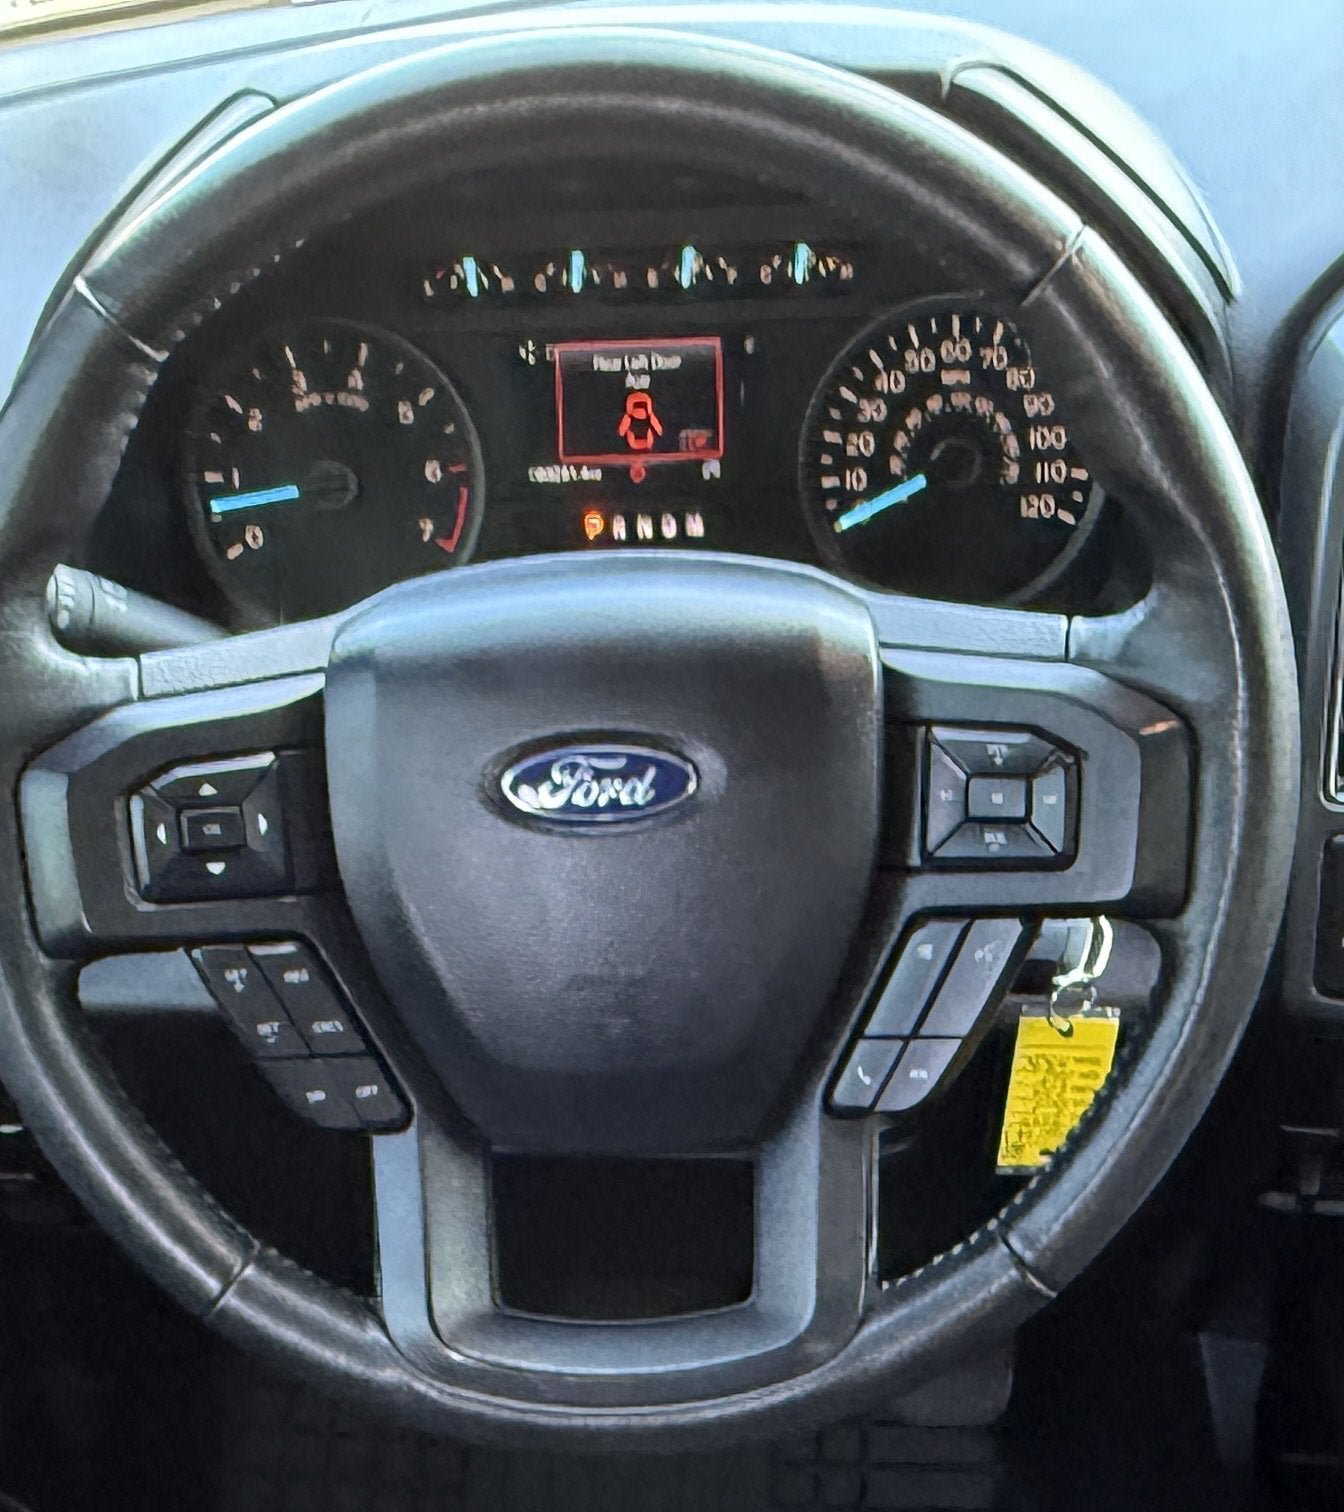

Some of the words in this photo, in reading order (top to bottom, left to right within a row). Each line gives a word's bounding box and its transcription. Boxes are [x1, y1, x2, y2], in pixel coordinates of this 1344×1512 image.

[940, 337, 973, 364] 60
[979, 345, 1008, 371] 70
[857, 397, 887, 423] 30
[1022, 392, 1055, 418] 90
[845, 430, 876, 457] 20
[1029, 424, 1067, 451] 100
[845, 466, 868, 491] 10
[1035, 458, 1067, 485] 110
[1020, 493, 1056, 519] 120
[245, 524, 264, 550] 0
[584, 510, 605, 541] P
[636, 512, 654, 540] N
[517, 755, 657, 810] Ford
